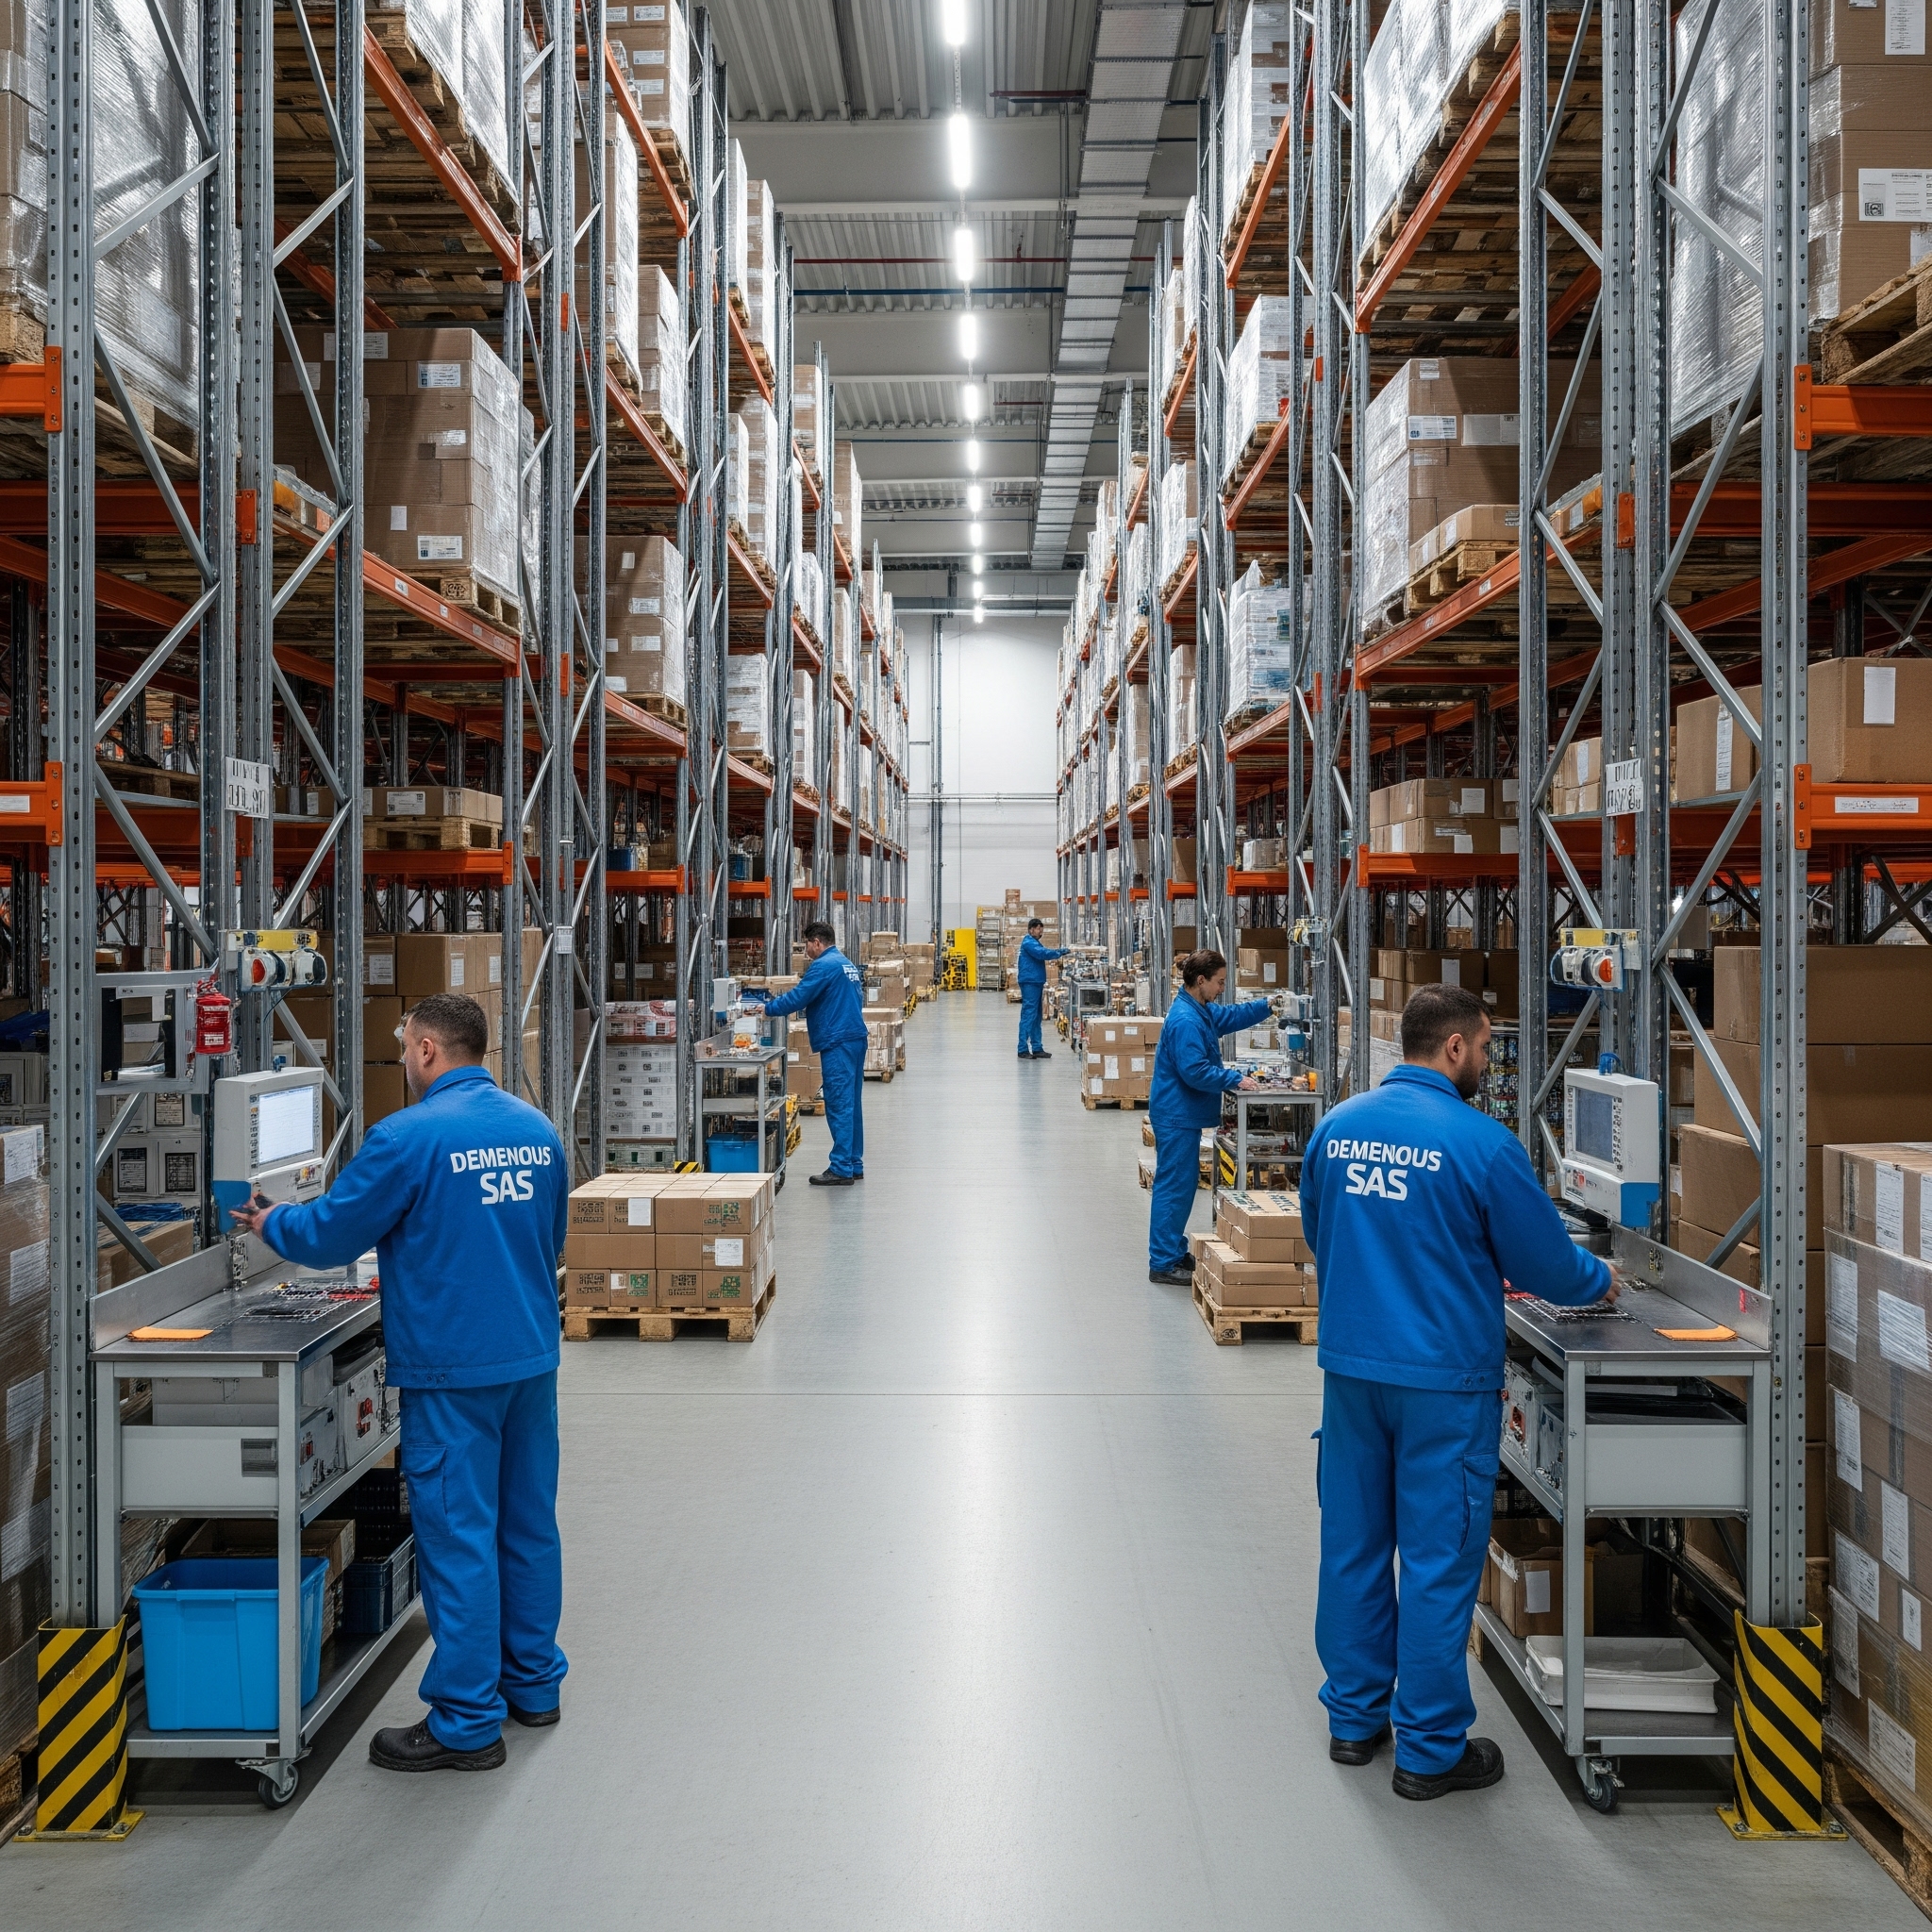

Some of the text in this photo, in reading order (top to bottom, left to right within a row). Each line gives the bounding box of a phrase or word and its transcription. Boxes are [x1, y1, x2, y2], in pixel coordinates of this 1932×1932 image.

[450, 1146, 551, 1174] DEMENOUS
[479, 1170, 534, 1205] SAS
[1345, 1162, 1408, 1201] SAS
